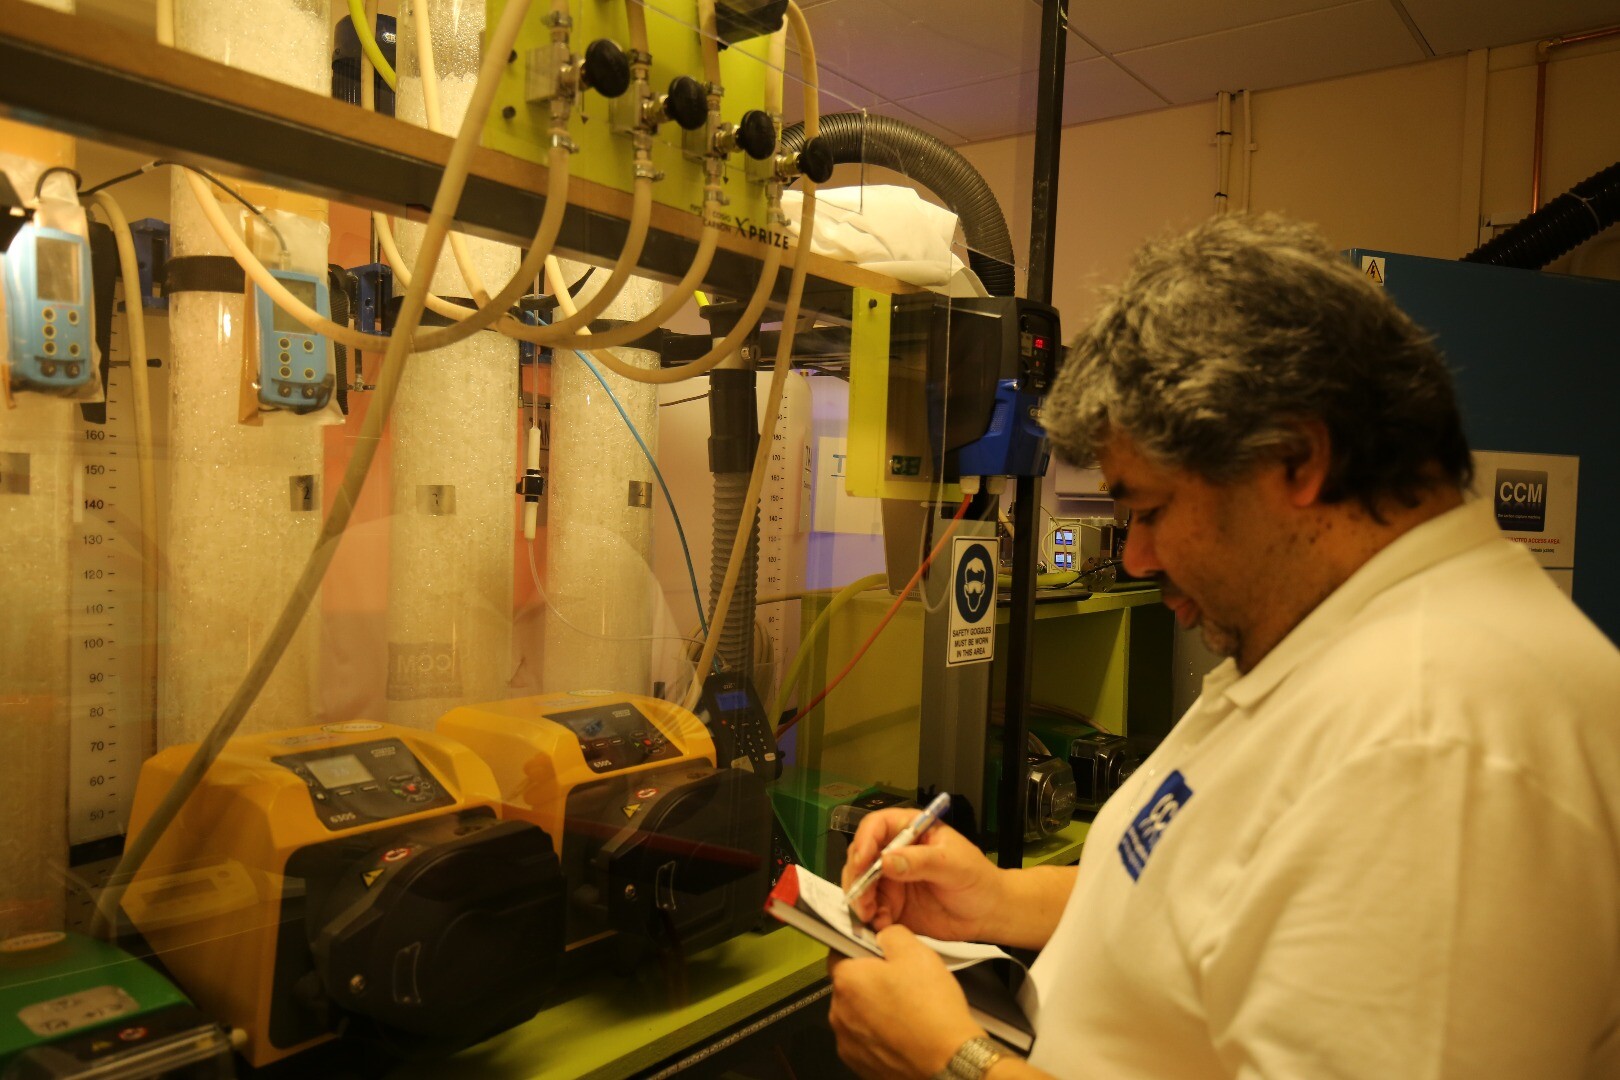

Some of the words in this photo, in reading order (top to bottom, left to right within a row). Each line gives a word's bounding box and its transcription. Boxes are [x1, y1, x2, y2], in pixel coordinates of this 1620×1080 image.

[735, 216, 789, 250] XPRIZE
[84, 430, 105, 440] 160
[84, 465, 105, 475] 150
[1499, 481, 1543, 503] CCM
[84, 499, 104, 510] 140
[83, 535, 103, 544] 130
[83, 569, 103, 580] 120
[85, 604, 103, 614] 110
[952, 629, 969, 637] SAFETY
[970, 626, 991, 635] GOGGLES
[83, 638, 104, 649] 100
[975, 637, 988, 645] WORN
[956, 650, 962, 658] IN
[973, 647, 985, 655] AREA
[89, 672, 104, 683] 90
[89, 707, 104, 718] 80
[90, 740, 105, 752] 70
[89, 775, 105, 787] 60
[89, 810, 104, 821] 50
